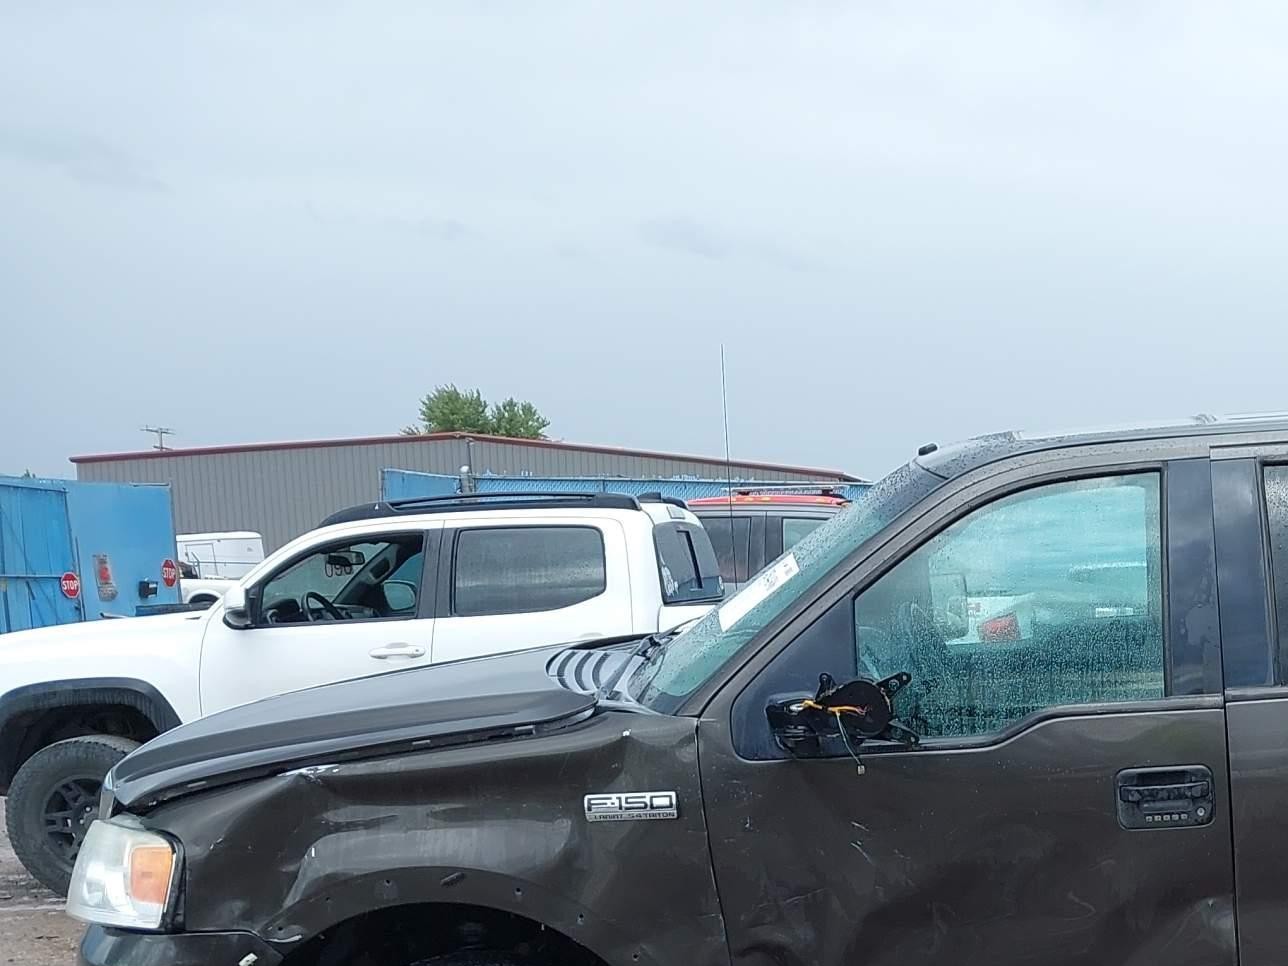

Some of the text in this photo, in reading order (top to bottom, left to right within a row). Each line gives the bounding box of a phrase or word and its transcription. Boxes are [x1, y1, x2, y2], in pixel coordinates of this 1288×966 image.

[162, 567, 176, 579] STOP
[62, 579, 79, 590] STOP
[587, 795, 673, 811] F-150
